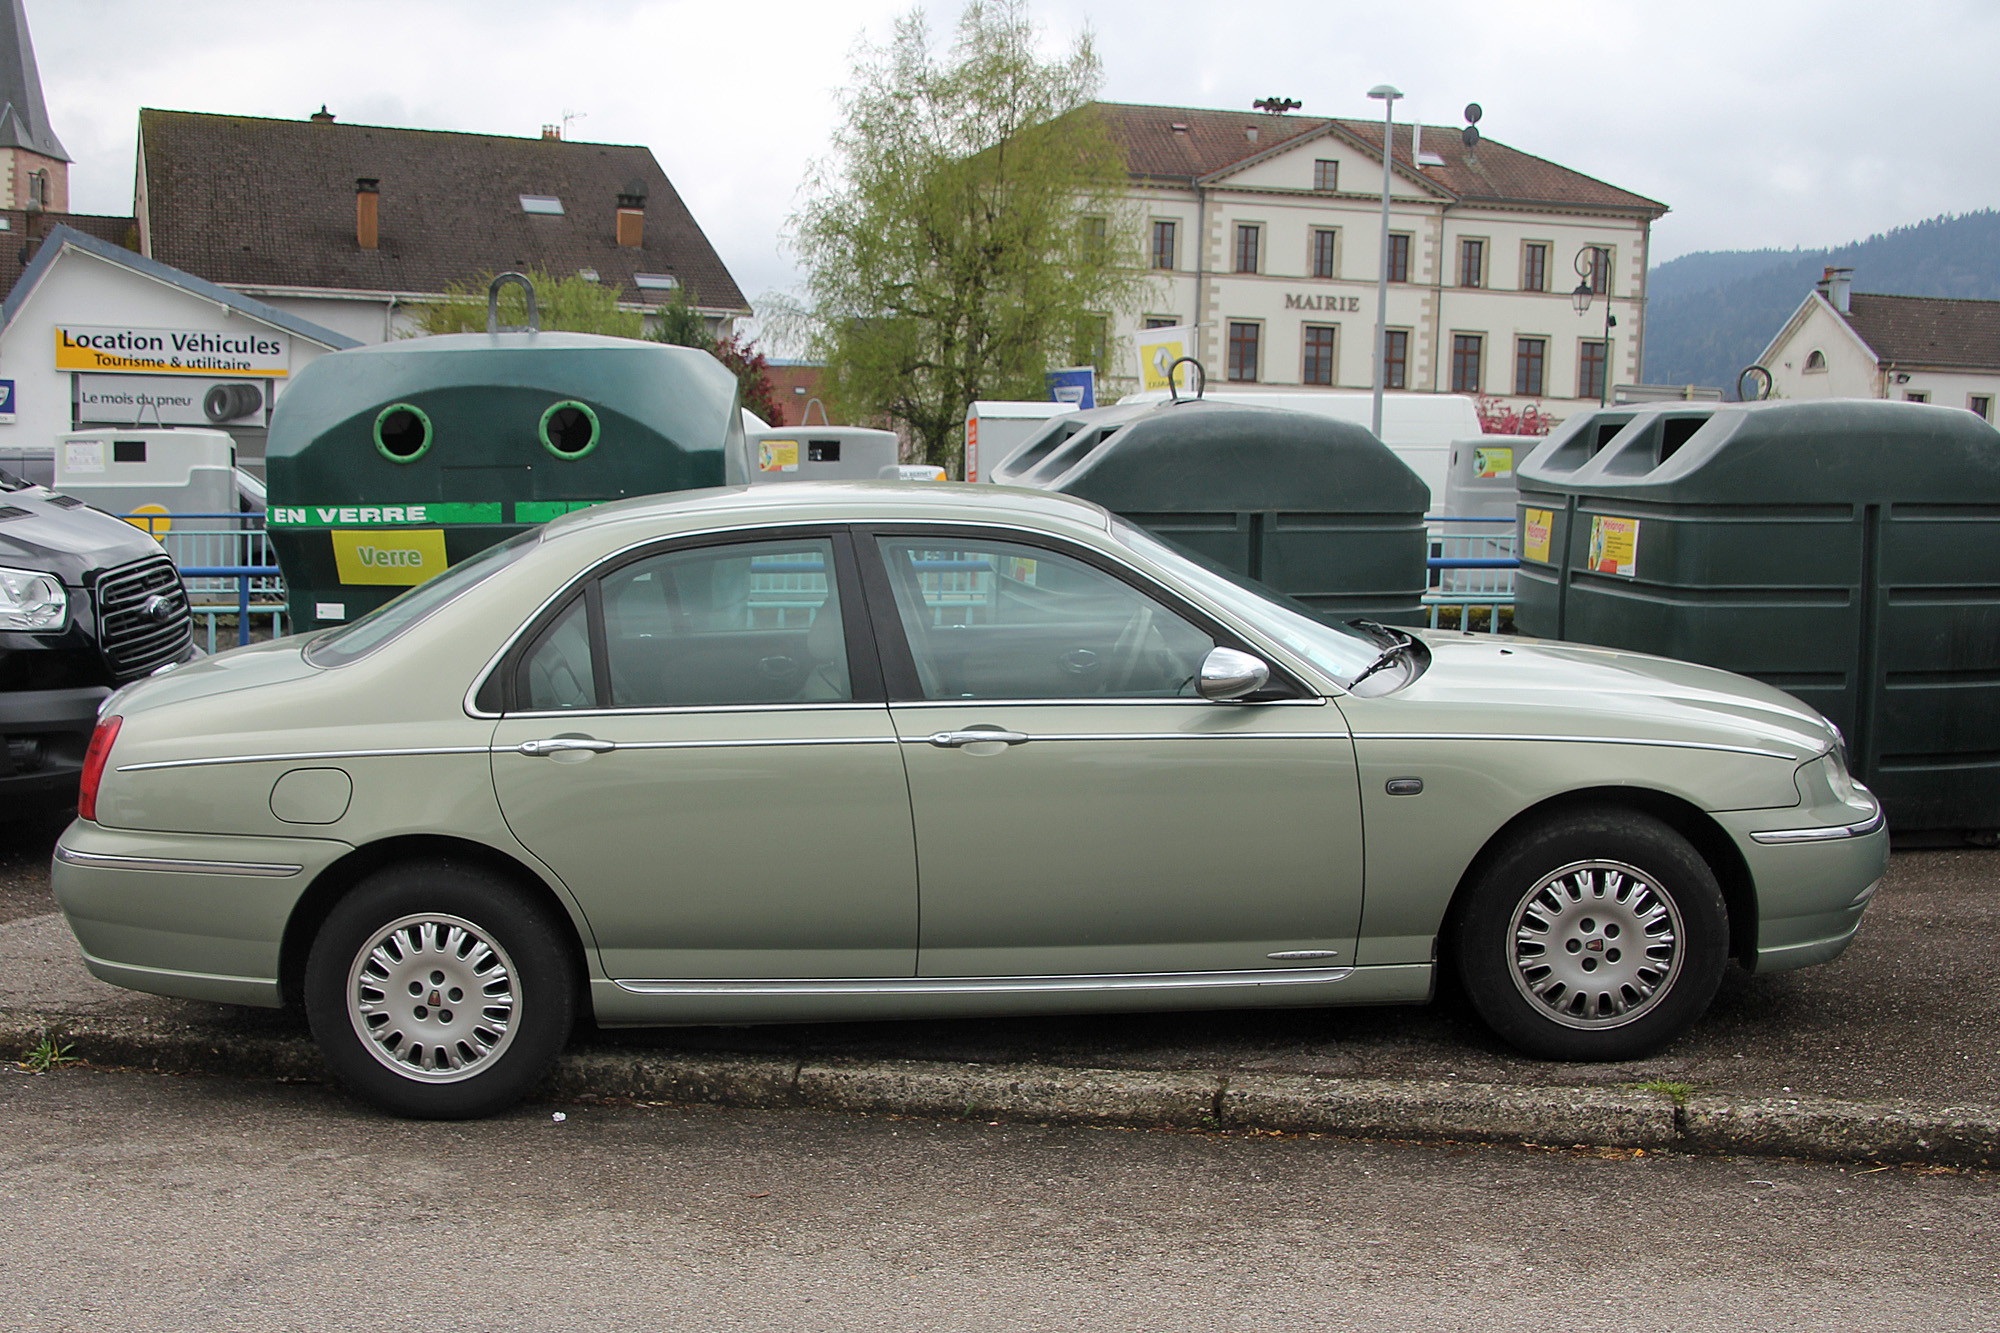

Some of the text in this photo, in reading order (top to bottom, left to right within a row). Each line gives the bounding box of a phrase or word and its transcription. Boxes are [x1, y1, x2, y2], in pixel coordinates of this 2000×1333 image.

[1285, 294, 1359, 311] MAIRIE
[63, 329, 281, 355] Location Véhicules
[94, 353, 252, 371] Tourisme & utilitaire
[82, 392, 192, 409] Le mois du pneu
[273, 508, 307, 524] EN
[316, 505, 427, 523] VERRE
[356, 545, 423, 568] Verre
